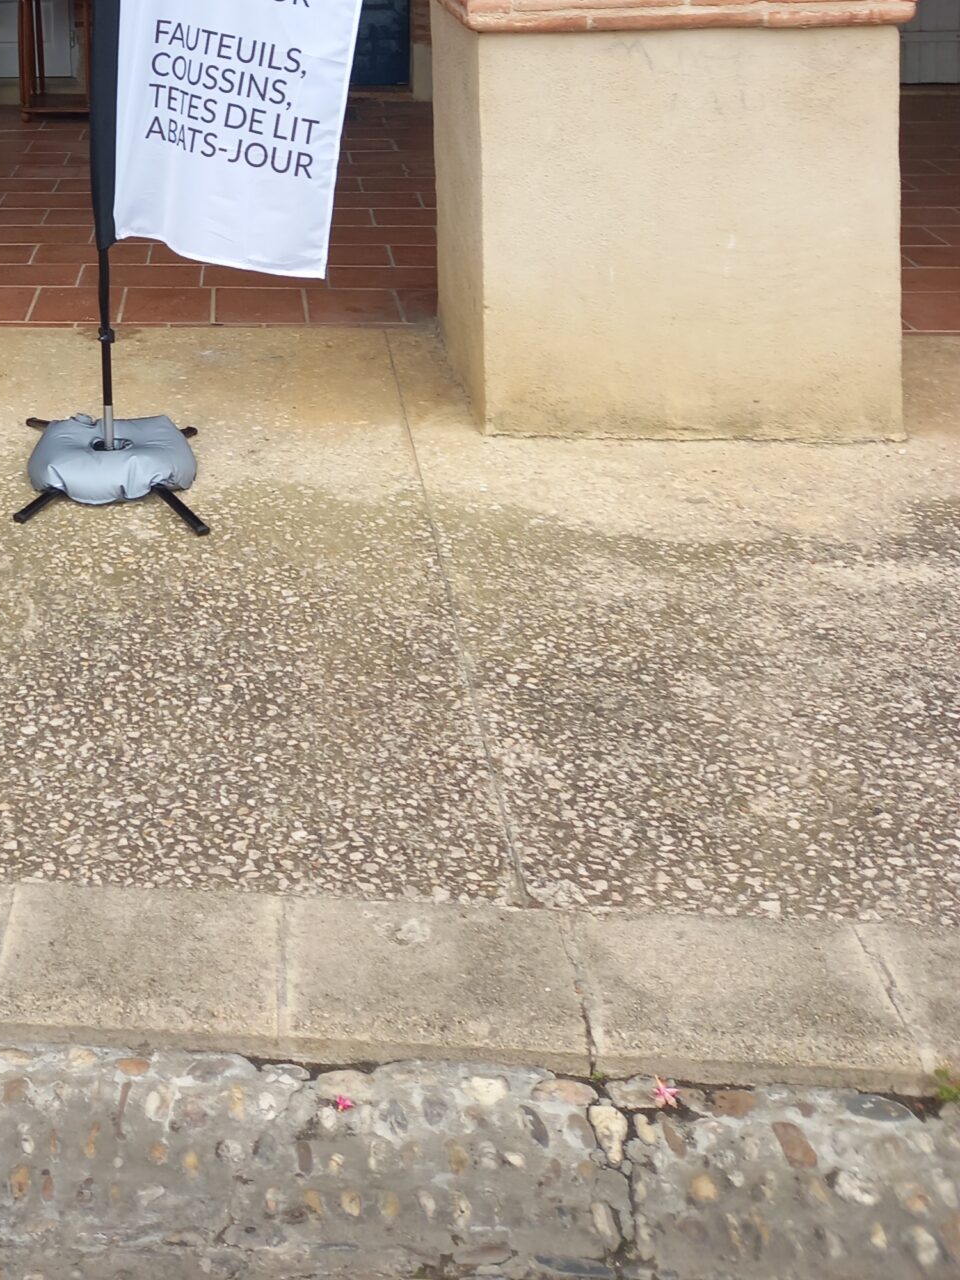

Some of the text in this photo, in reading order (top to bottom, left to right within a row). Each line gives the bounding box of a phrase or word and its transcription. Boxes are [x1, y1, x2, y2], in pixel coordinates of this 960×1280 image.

[154, 19, 307, 79] FAUTEUILS,
[151, 52, 293, 111] COUSSINS,
[147, 82, 321, 146] TETES DE LIT
[145, 115, 314, 179] ABATS-JOUR
